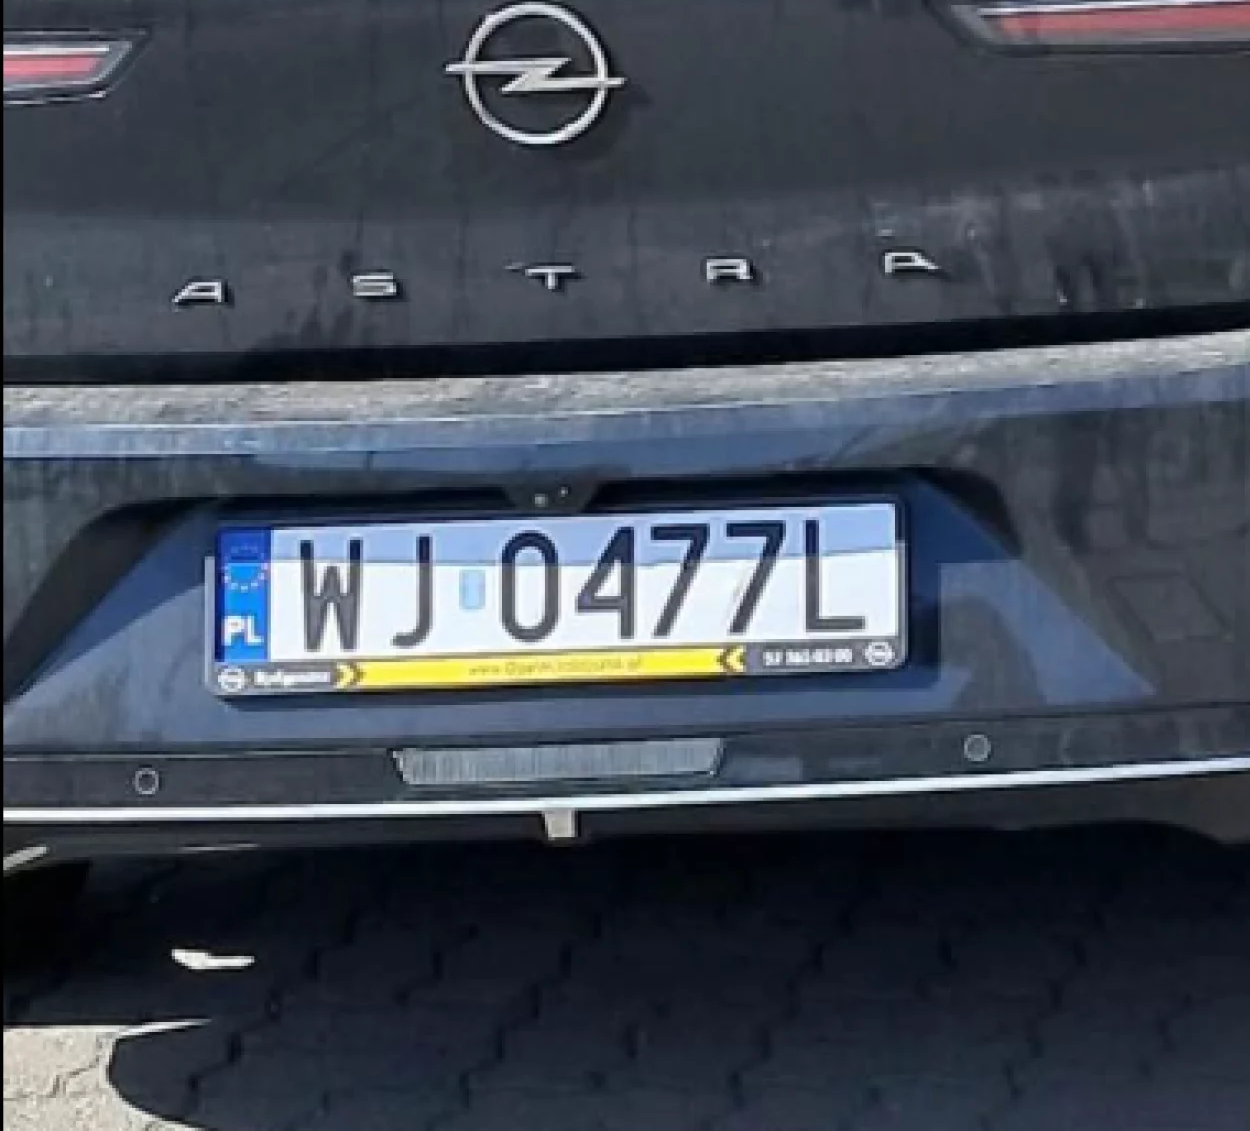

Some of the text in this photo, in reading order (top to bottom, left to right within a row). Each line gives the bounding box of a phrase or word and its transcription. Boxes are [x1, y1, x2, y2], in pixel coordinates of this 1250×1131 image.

[173, 251, 940, 305] ASTRA
[299, 519, 867, 654] WJ 0477L
[224, 616, 264, 646] PL
